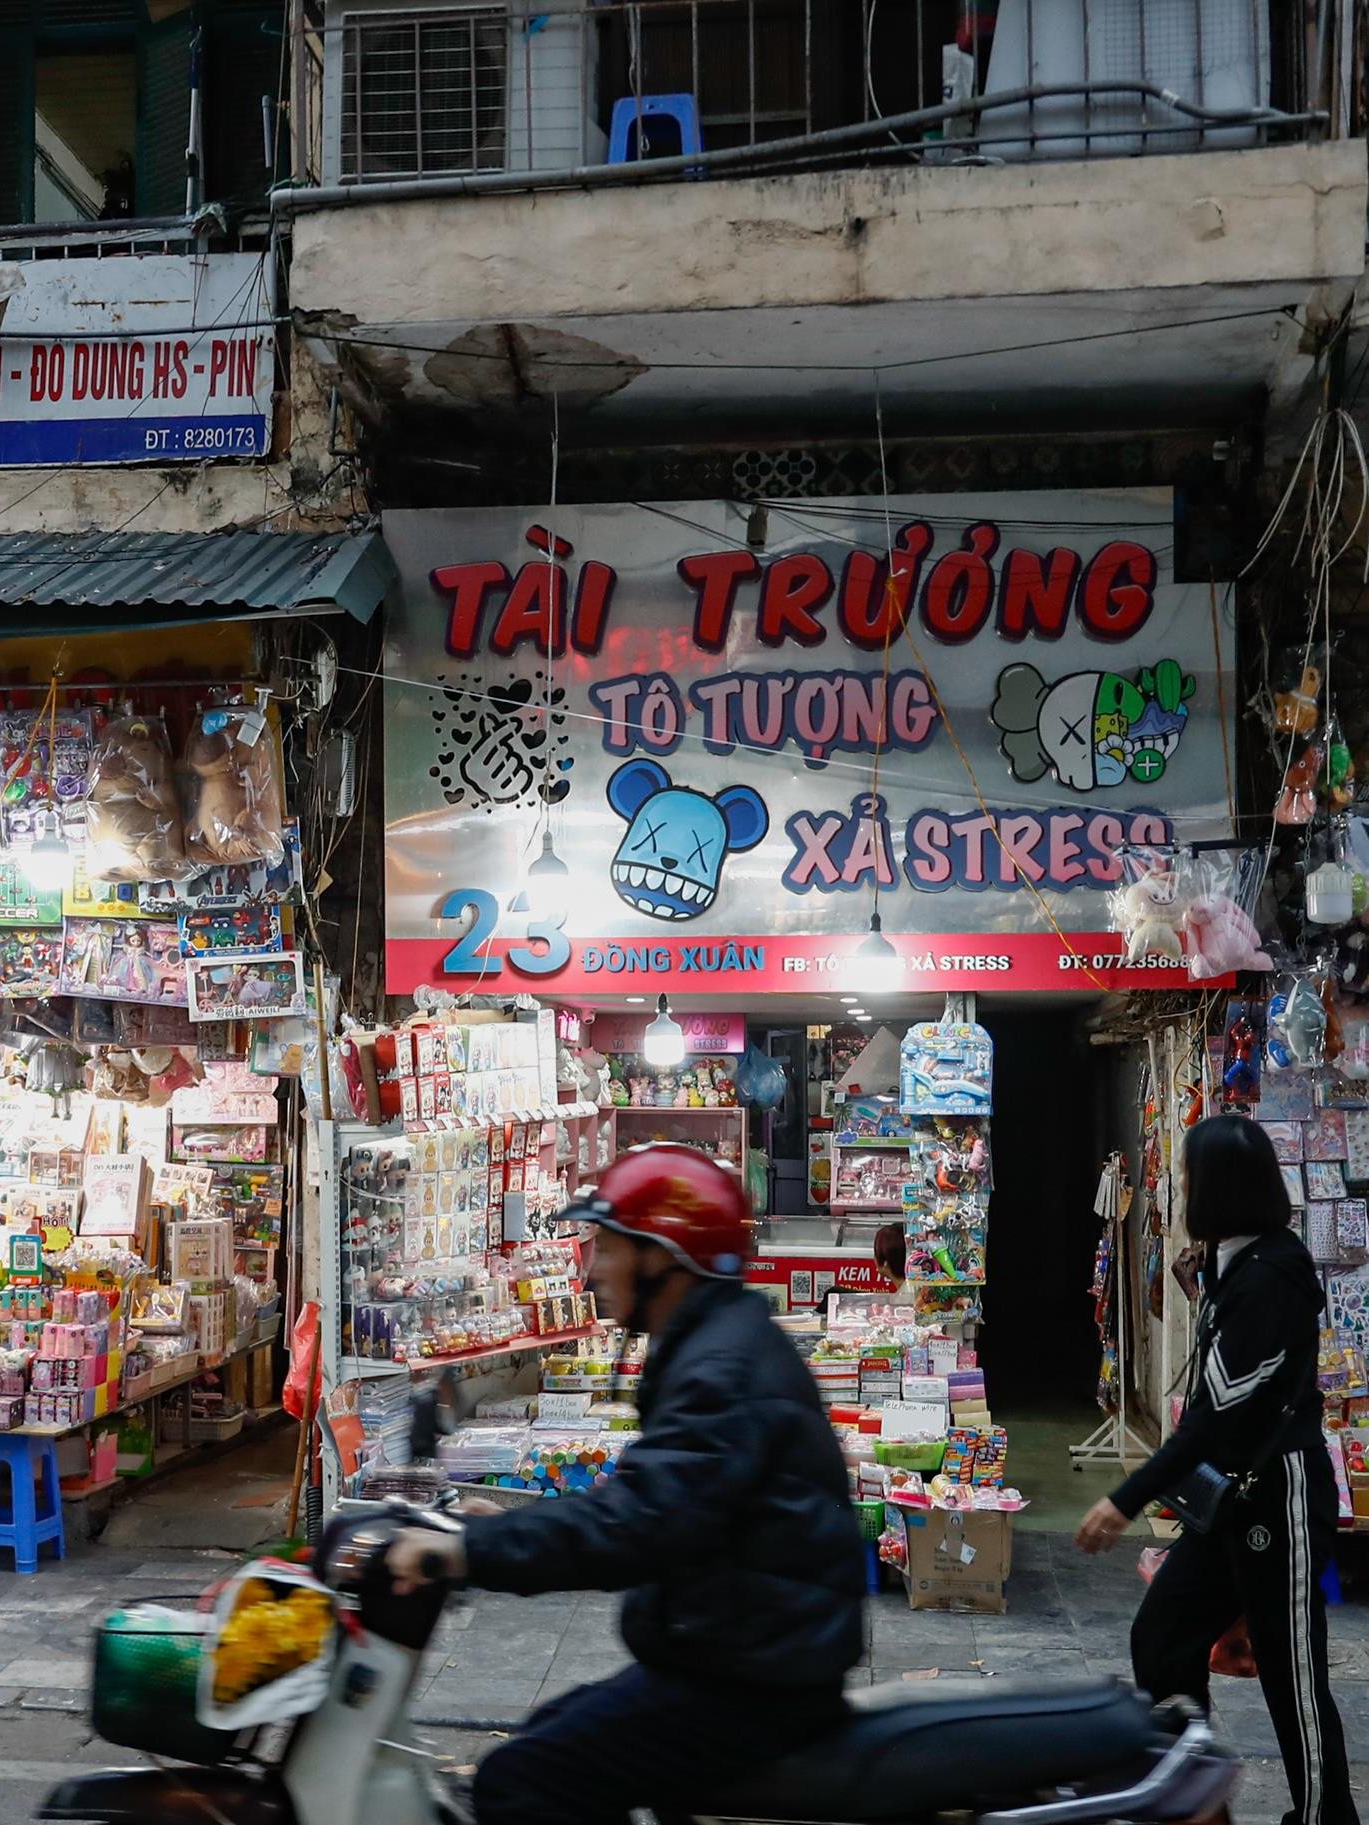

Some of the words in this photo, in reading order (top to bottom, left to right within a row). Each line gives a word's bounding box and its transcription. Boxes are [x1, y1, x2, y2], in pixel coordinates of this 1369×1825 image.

[144, 428, 171, 449] ĐT
[184, 428, 255, 449] 8280173
[430, 524, 617, 659] TÀI
[676, 520, 1158, 654] TRƯỞNG
[594, 672, 683, 754] TÔ
[697, 672, 939, 769] TƯỢNG
[784, 792, 893, 893] XẢ
[908, 808, 1174, 891] STRESS
[435, 887, 571, 977] 23
[582, 944, 671, 974] ĐỒNG
[679, 941, 765, 973] XUÂN
[783, 956, 811, 972] FB:
[911, 951, 934, 970] XẢ
[939, 956, 1010, 971] STRESS
[1058, 956, 1089, 970] ĐT:
[694, 1039, 728, 1050] STRESS
[40, 1214, 70, 1227] HOT!
[838, 1266, 871, 1282] KEM
